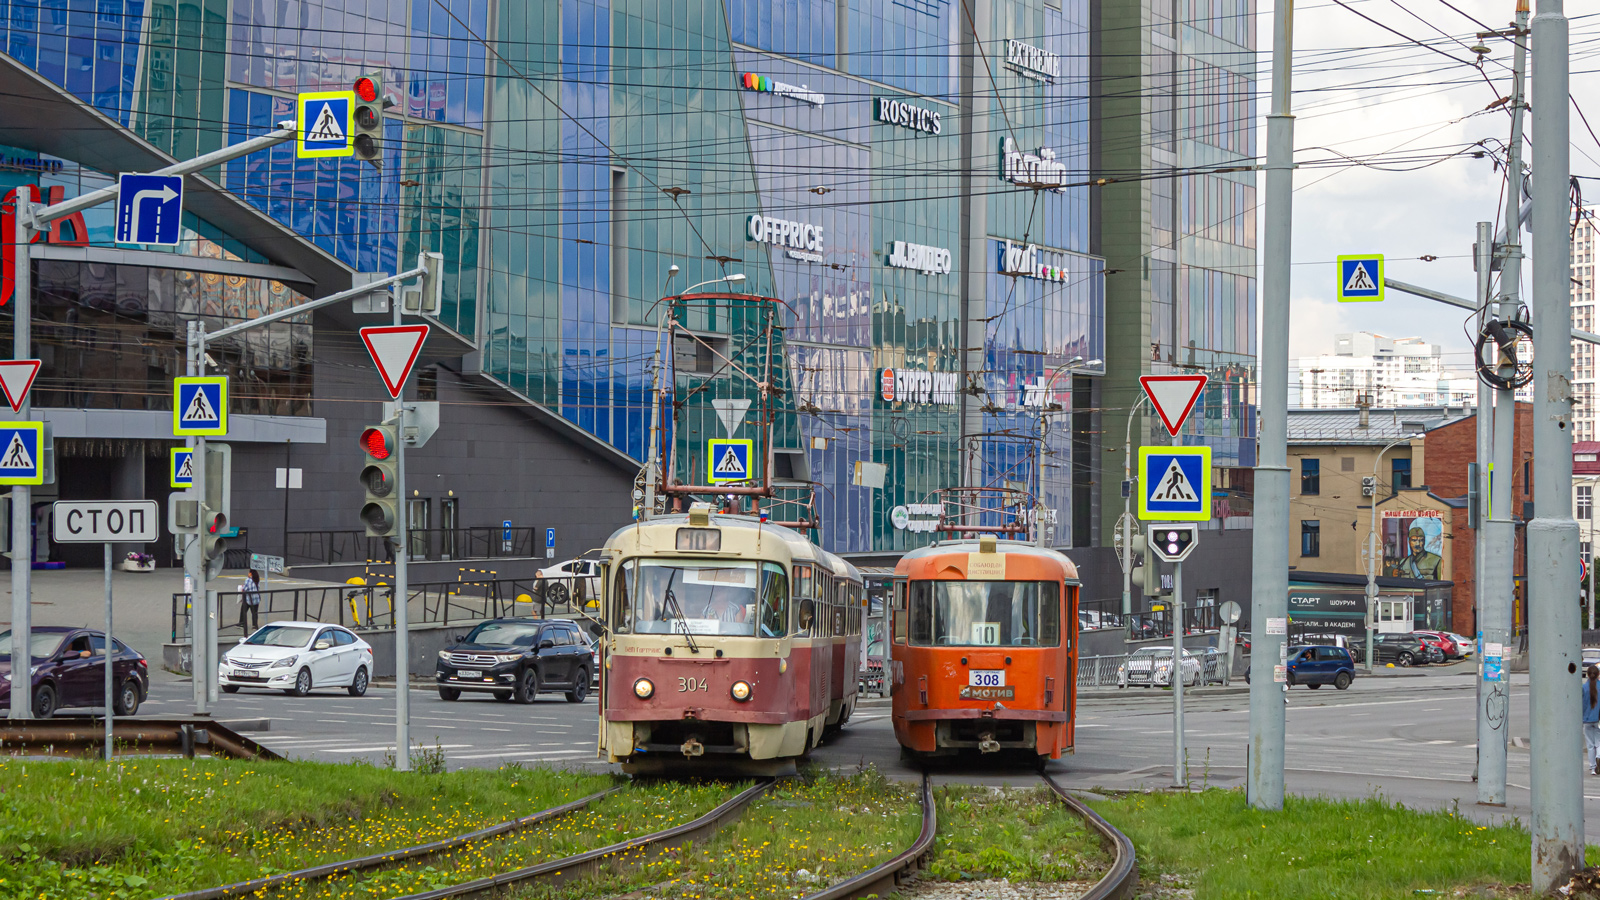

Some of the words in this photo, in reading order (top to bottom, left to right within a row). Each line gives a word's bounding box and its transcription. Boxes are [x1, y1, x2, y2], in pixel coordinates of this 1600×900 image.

[1008, 39, 1060, 77] EXTREME
[879, 97, 941, 135] ROSTIC'S
[750, 214, 824, 252] OFFPRICE
[889, 240, 952, 276] М.ВИДЕО
[896, 368, 932, 404] БУРГЕР
[933, 371, 958, 406] КИНГ
[66, 508, 145, 535] СТОП
[1291, 597, 1321, 605] СТАРТ
[976, 626, 995, 645] 10
[677, 676, 708, 692] 304
[972, 689, 1014, 698] МОТИВ
[974, 674, 1000, 686] 308
